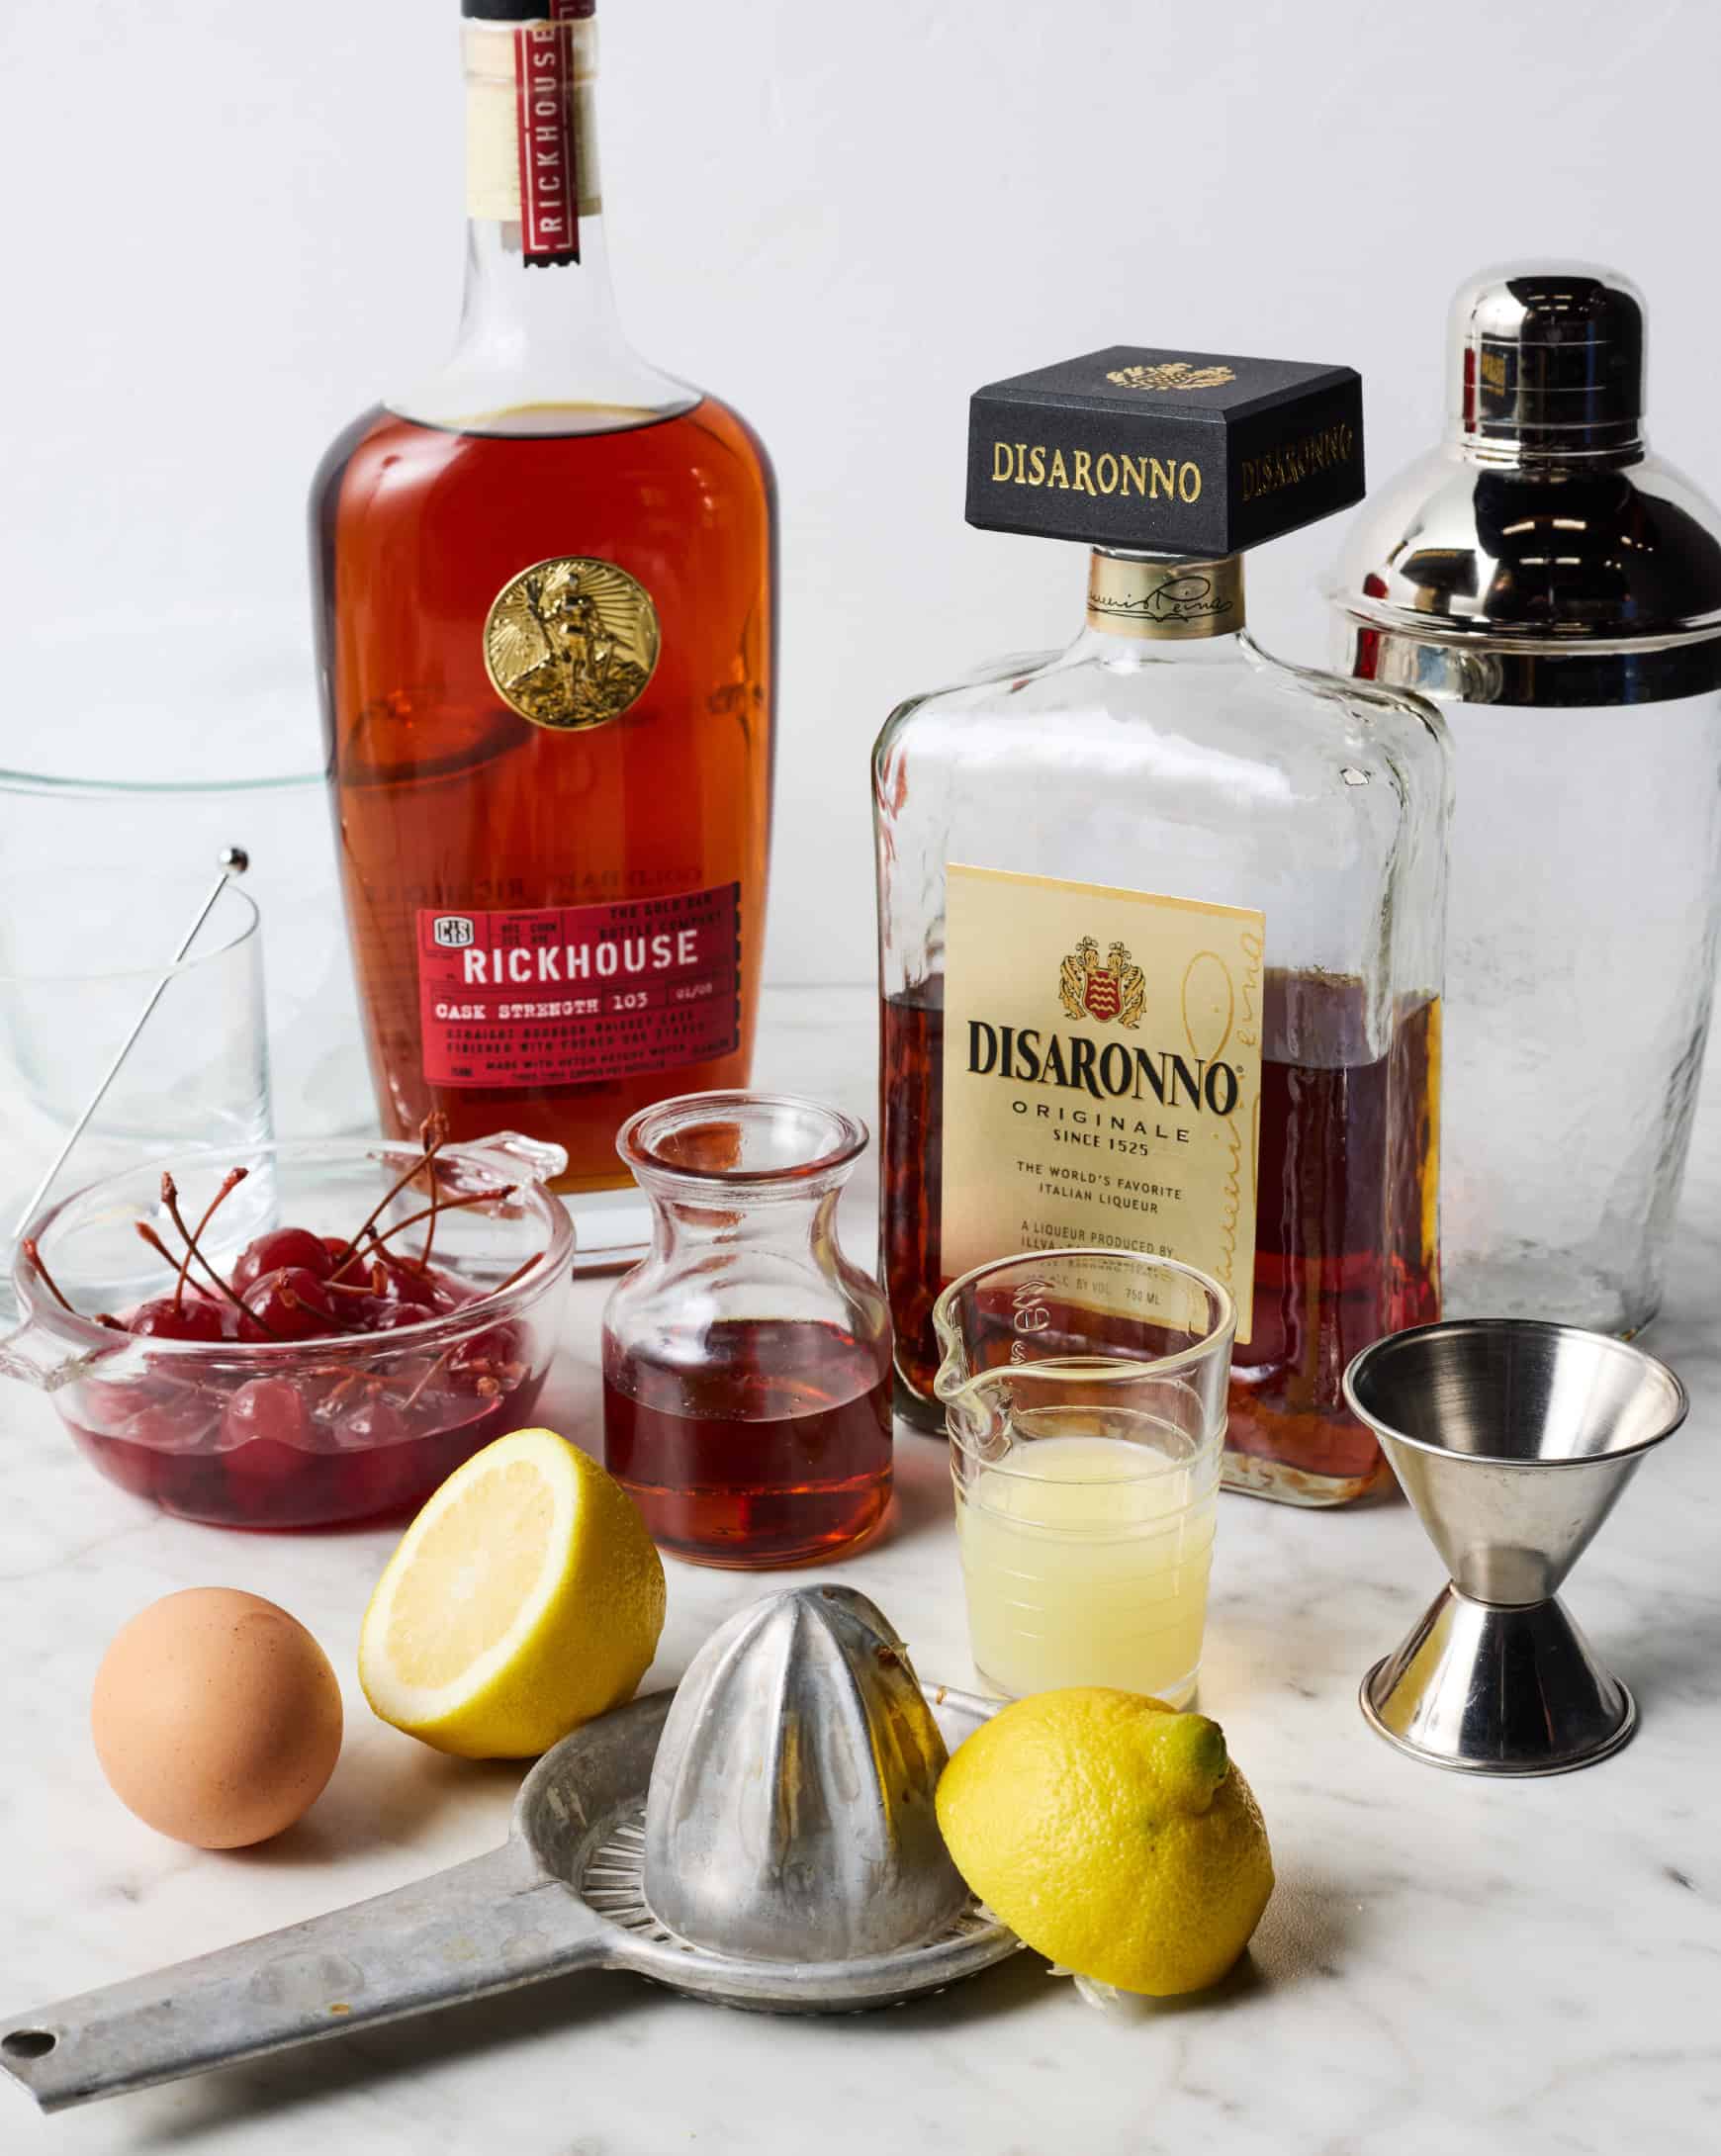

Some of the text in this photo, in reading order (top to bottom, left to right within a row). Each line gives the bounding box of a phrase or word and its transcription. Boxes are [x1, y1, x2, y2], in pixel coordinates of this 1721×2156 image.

[534, 31, 563, 232] RICKHOUSE
[992, 442, 1203, 503] DISARONNO
[463, 930, 698, 984] RICKHOUSE
[435, 1003, 486, 1020] CASK
[498, 998, 599, 1020] STRENGTH
[612, 992, 649, 1011] 103
[966, 1020, 1238, 1117] DISARONNO
[1012, 1101, 1191, 1143] ORIGINALE
[1053, 1128, 1149, 1156] SINCE 1525
[1016, 1161, 1182, 1201] THE WORLD'S FAVORITE
[1039, 1183, 1158, 1213] ITALIAN LIQUEUR
[1021, 1220, 1029, 1231] A
[1034, 1223, 1085, 1241] LIQUEUR
[1091, 1232, 1154, 1255] PRODUCED
[1159, 1244, 1174, 1259] BY
